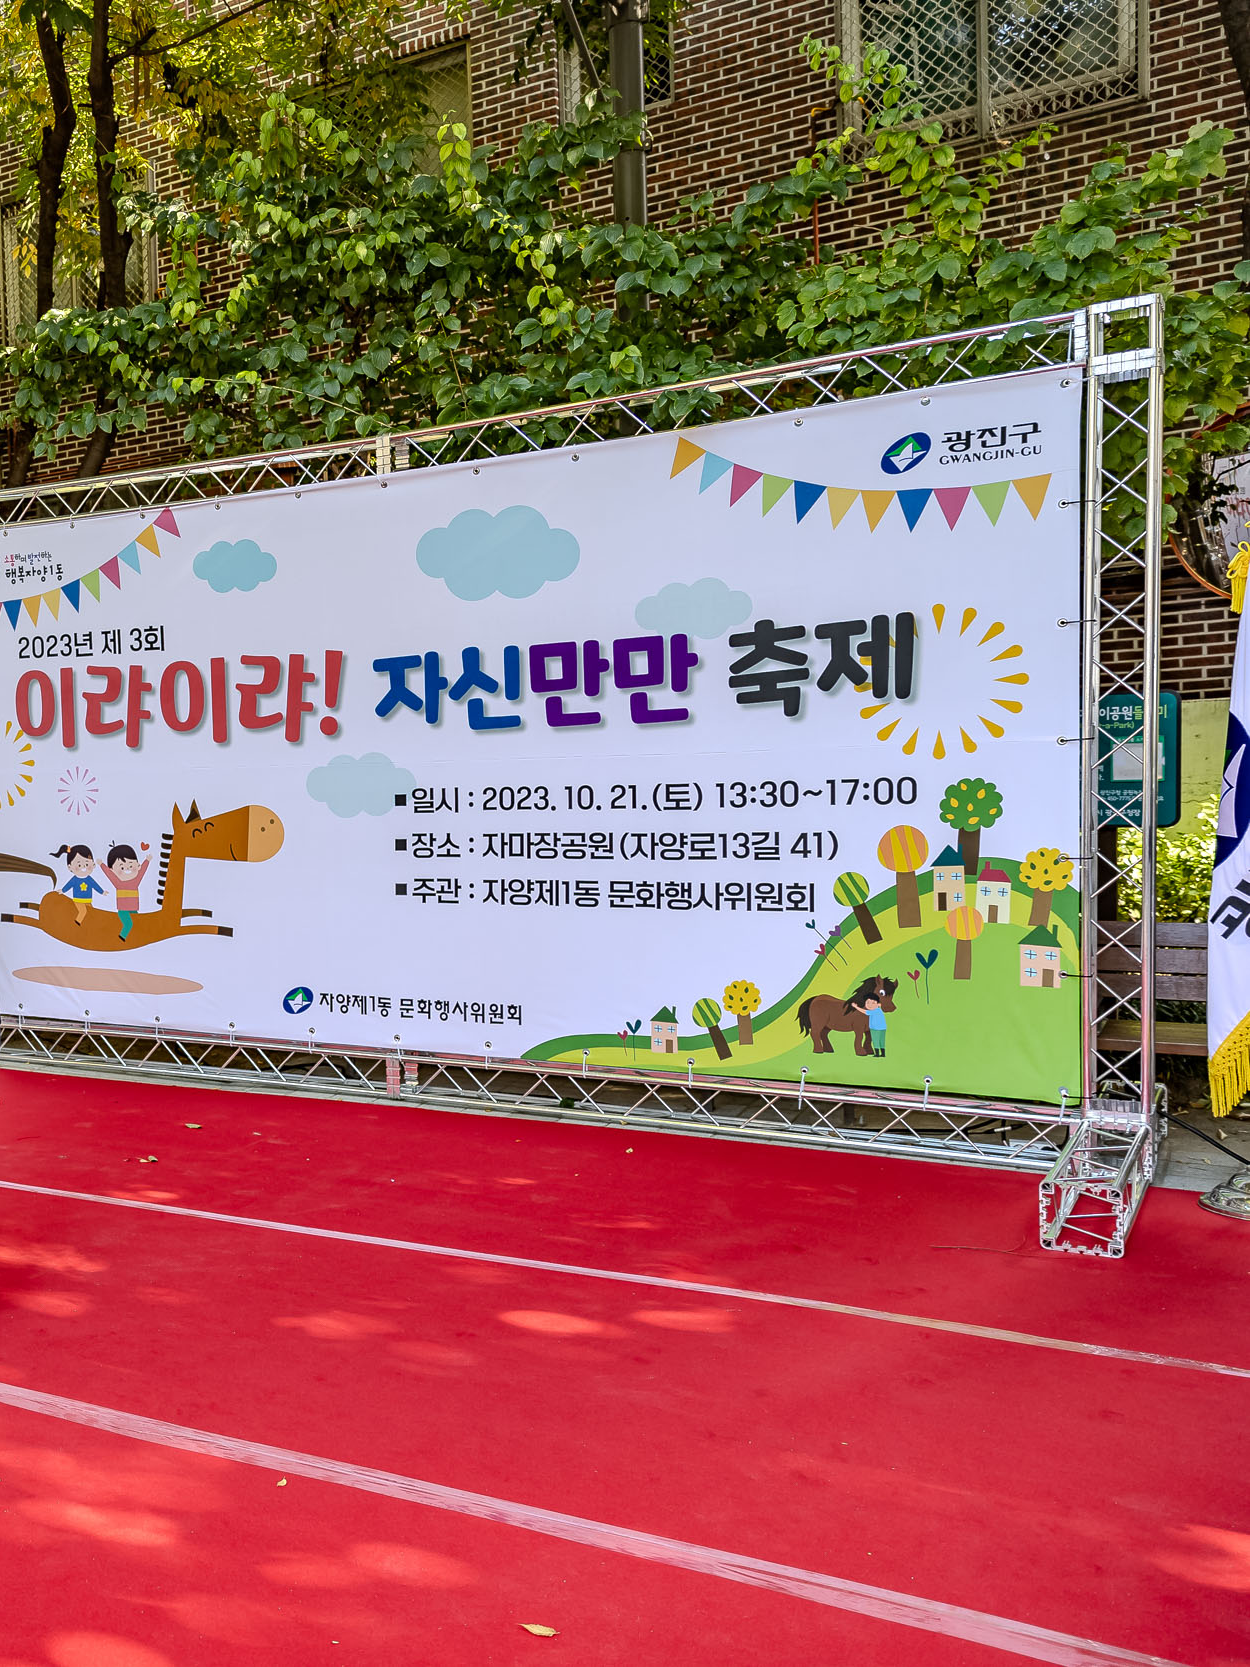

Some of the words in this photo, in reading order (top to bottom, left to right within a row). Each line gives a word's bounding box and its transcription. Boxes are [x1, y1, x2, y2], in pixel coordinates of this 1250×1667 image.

[941, 421, 1042, 453] 광진구
[939, 445, 1042, 466] GWANGJIN-GU
[18, 631, 94, 660] 2023년
[101, 628, 122, 655] 제
[129, 625, 165, 652] 3회
[14, 649, 344, 749] 이랴이랴!
[372, 633, 700, 731] 자신만만
[727, 611, 916, 718] 축제
[411, 786, 459, 814] 일시
[482, 785, 557, 811] 2023.
[564, 783, 602, 811] 10.
[715, 776, 918, 809] 13:30~17:00
[411, 832, 461, 859] 장소
[790, 830, 839, 861] 41)
[411, 877, 461, 904] 주관
[482, 877, 600, 908] 자양제1동
[607, 880, 815, 912] 문화행사위원회
[319, 992, 392, 1018] 자양제1동
[399, 998, 522, 1025] 문화행사위원회
